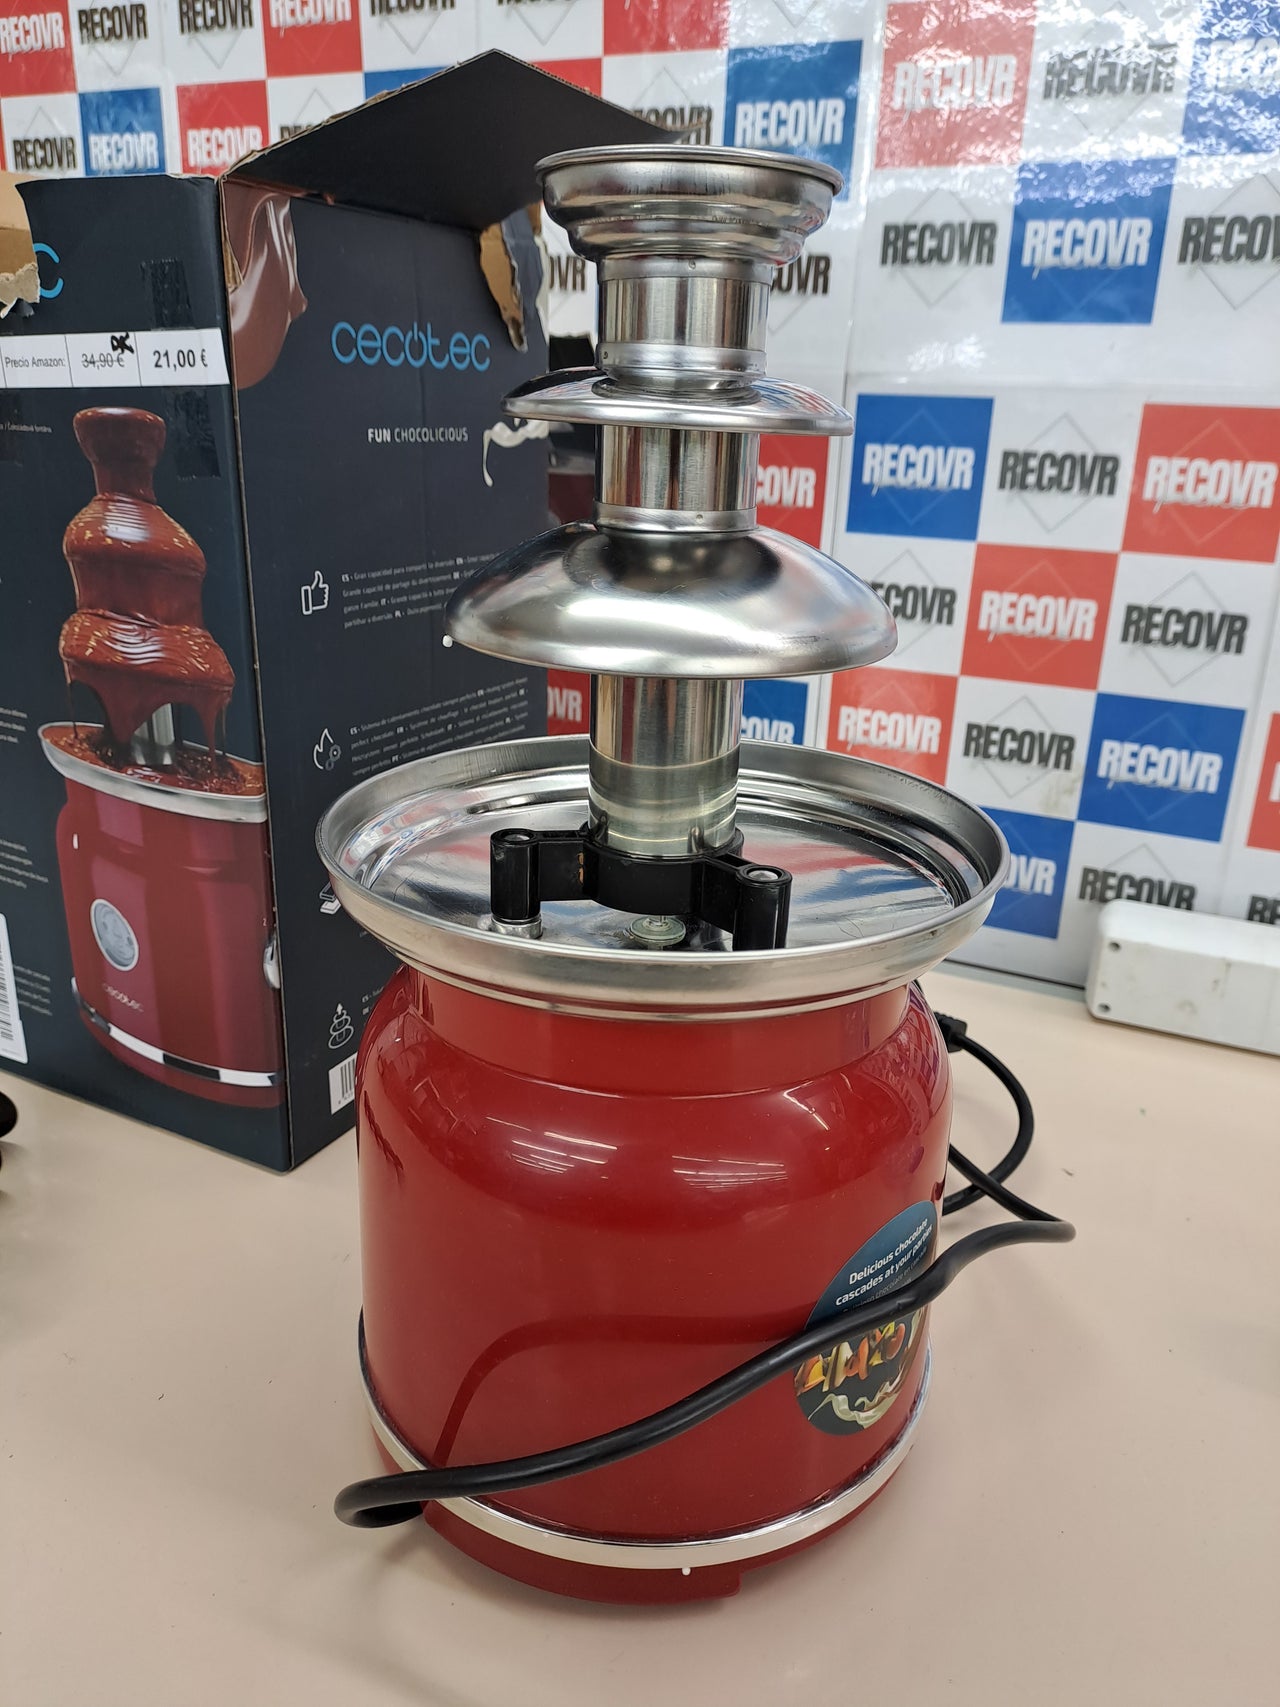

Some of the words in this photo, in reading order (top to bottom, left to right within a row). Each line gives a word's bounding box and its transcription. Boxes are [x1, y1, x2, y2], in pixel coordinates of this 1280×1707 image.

[0, 12, 66, 54] RECOVR
[78, 3, 149, 44] RECOVR
[176, 0, 254, 35] RECOVR
[269, 0, 353, 28] RECOVR
[735, 98, 846, 147] RECOVR
[12, 135, 77, 170] RECOVR
[87, 131, 159, 170] RECOVR
[881, 220, 999, 268] RECOVR
[1021, 217, 1153, 268] RECOVR
[5, 355, 29, 368] Precio
[31, 355, 66, 368] Amazon:
[153, 349, 196, 372] 21,00
[200, 351, 208, 368] €
[331, 321, 491, 372] cecotec
[368, 428, 391, 443] FUN
[394, 427, 469, 443] CHOCOLICIOUS
[862, 442, 976, 492] RECOVR
[999, 450, 1120, 496] RECOVR
[1143, 455, 1279, 509] RECOVR
[979, 590, 1098, 641] RECOVR
[1121, 603, 1250, 655] RECOVR
[837, 705, 942, 755] RECOVR
[963, 721, 1076, 771] RECOVR
[1097, 738, 1223, 795] RECOVR
[1078, 865, 1196, 911] RECOVR
[835, 1273, 884, 1306] cascades
[884, 1265, 895, 1279] at
[895, 1249, 912, 1273] your
[912, 1224, 933, 1257] parties
[849, 1251, 895, 1285] Delicious
[894, 1218, 929, 1257] chocolate
